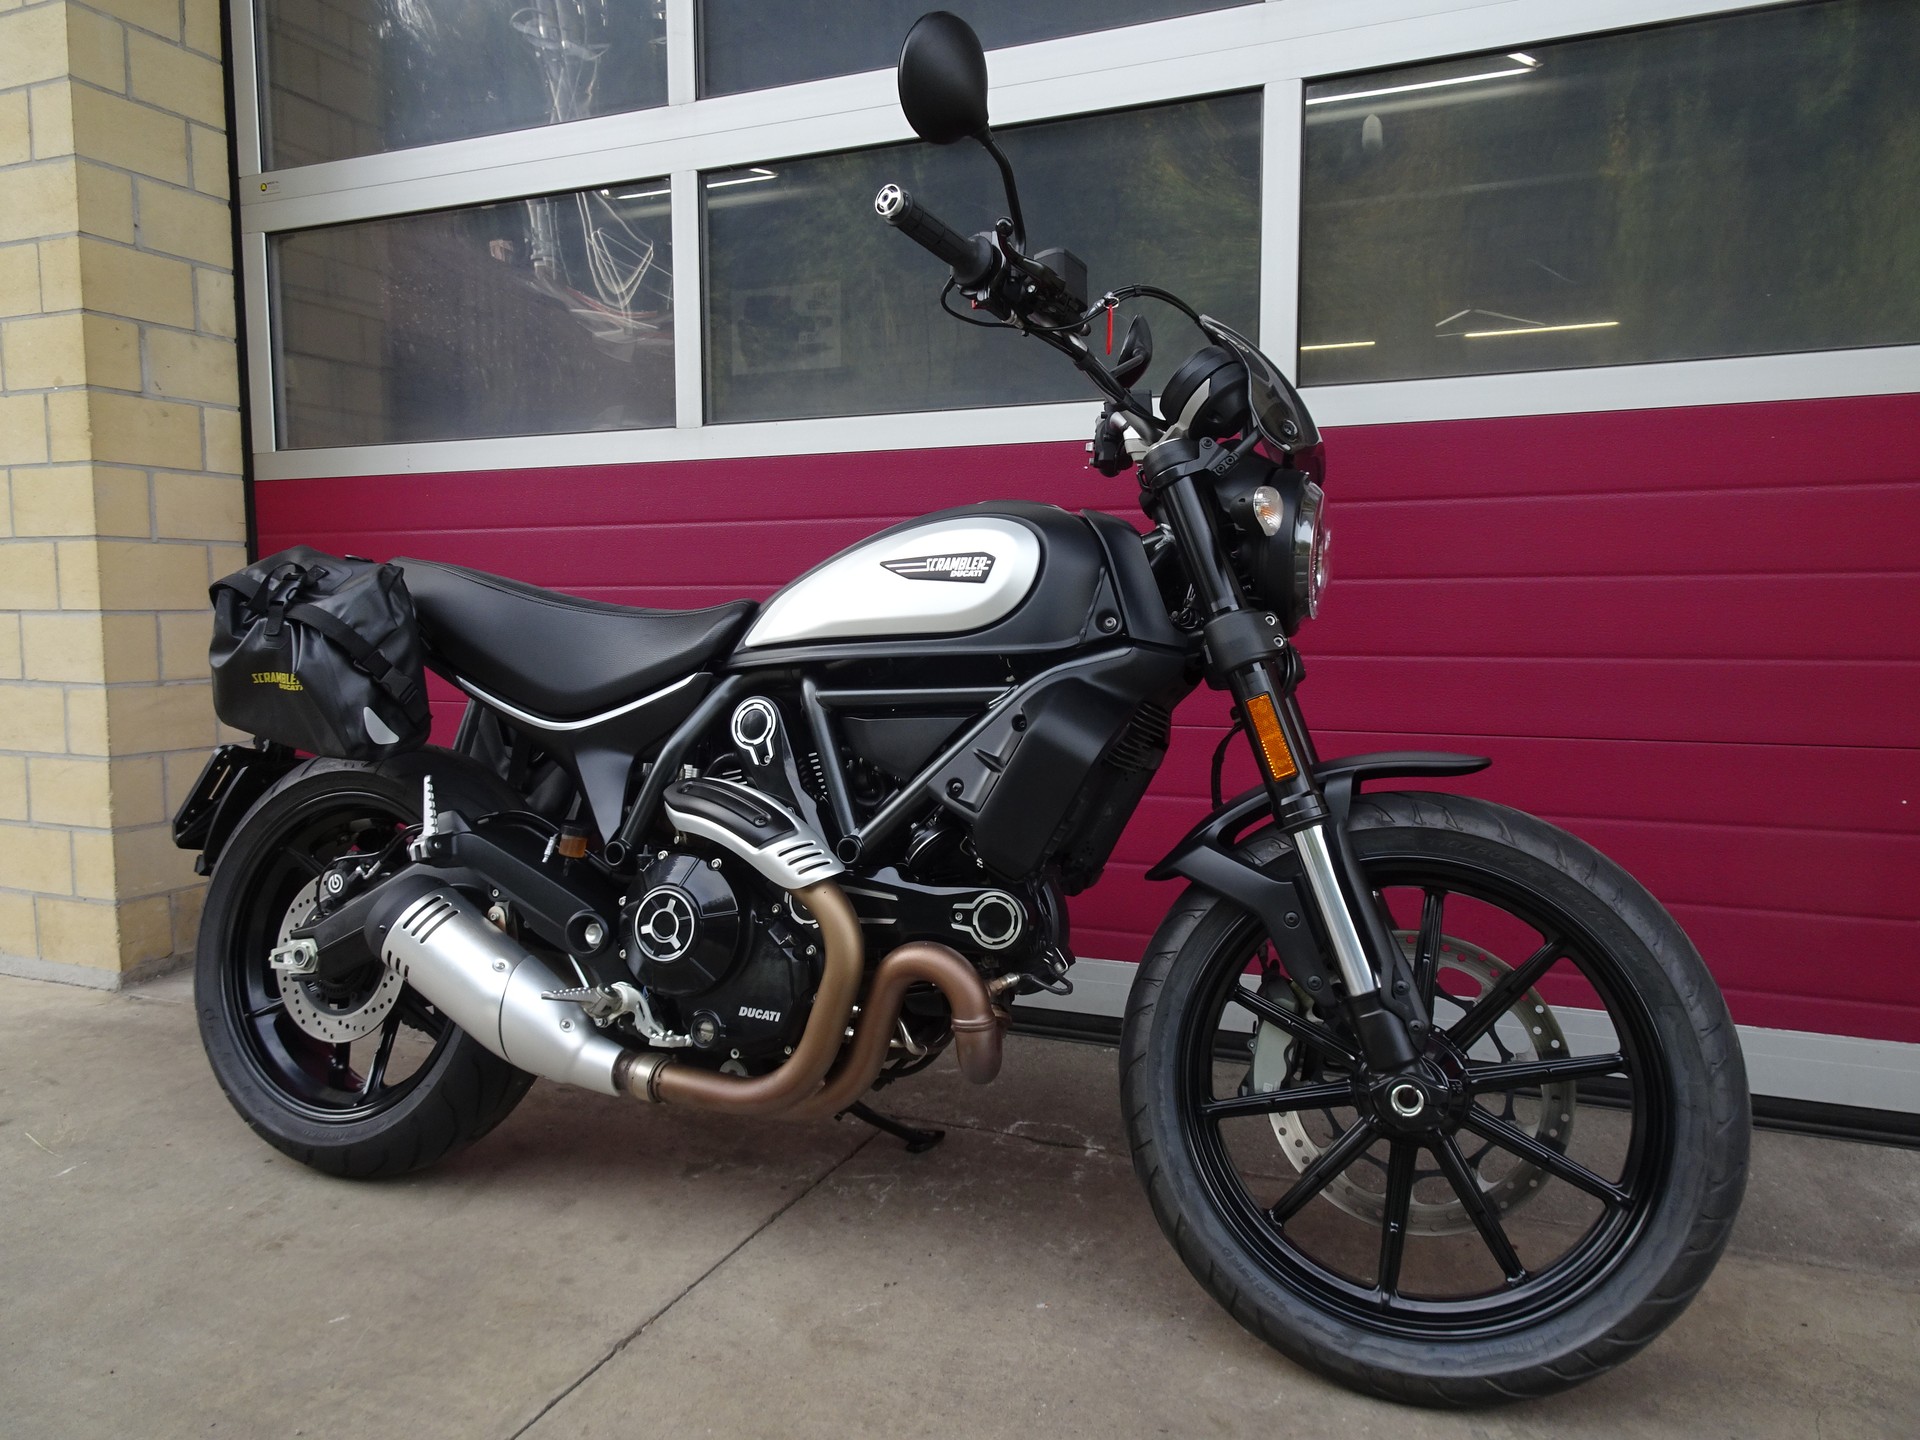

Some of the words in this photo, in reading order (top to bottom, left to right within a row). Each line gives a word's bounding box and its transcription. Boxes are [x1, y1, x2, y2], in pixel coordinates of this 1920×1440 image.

[926, 556, 989, 571] SCRAMBLER
[950, 570, 983, 578] DUCATI
[251, 672, 300, 685] SCRAMBLE
[738, 1006, 781, 1023] DUCATI
